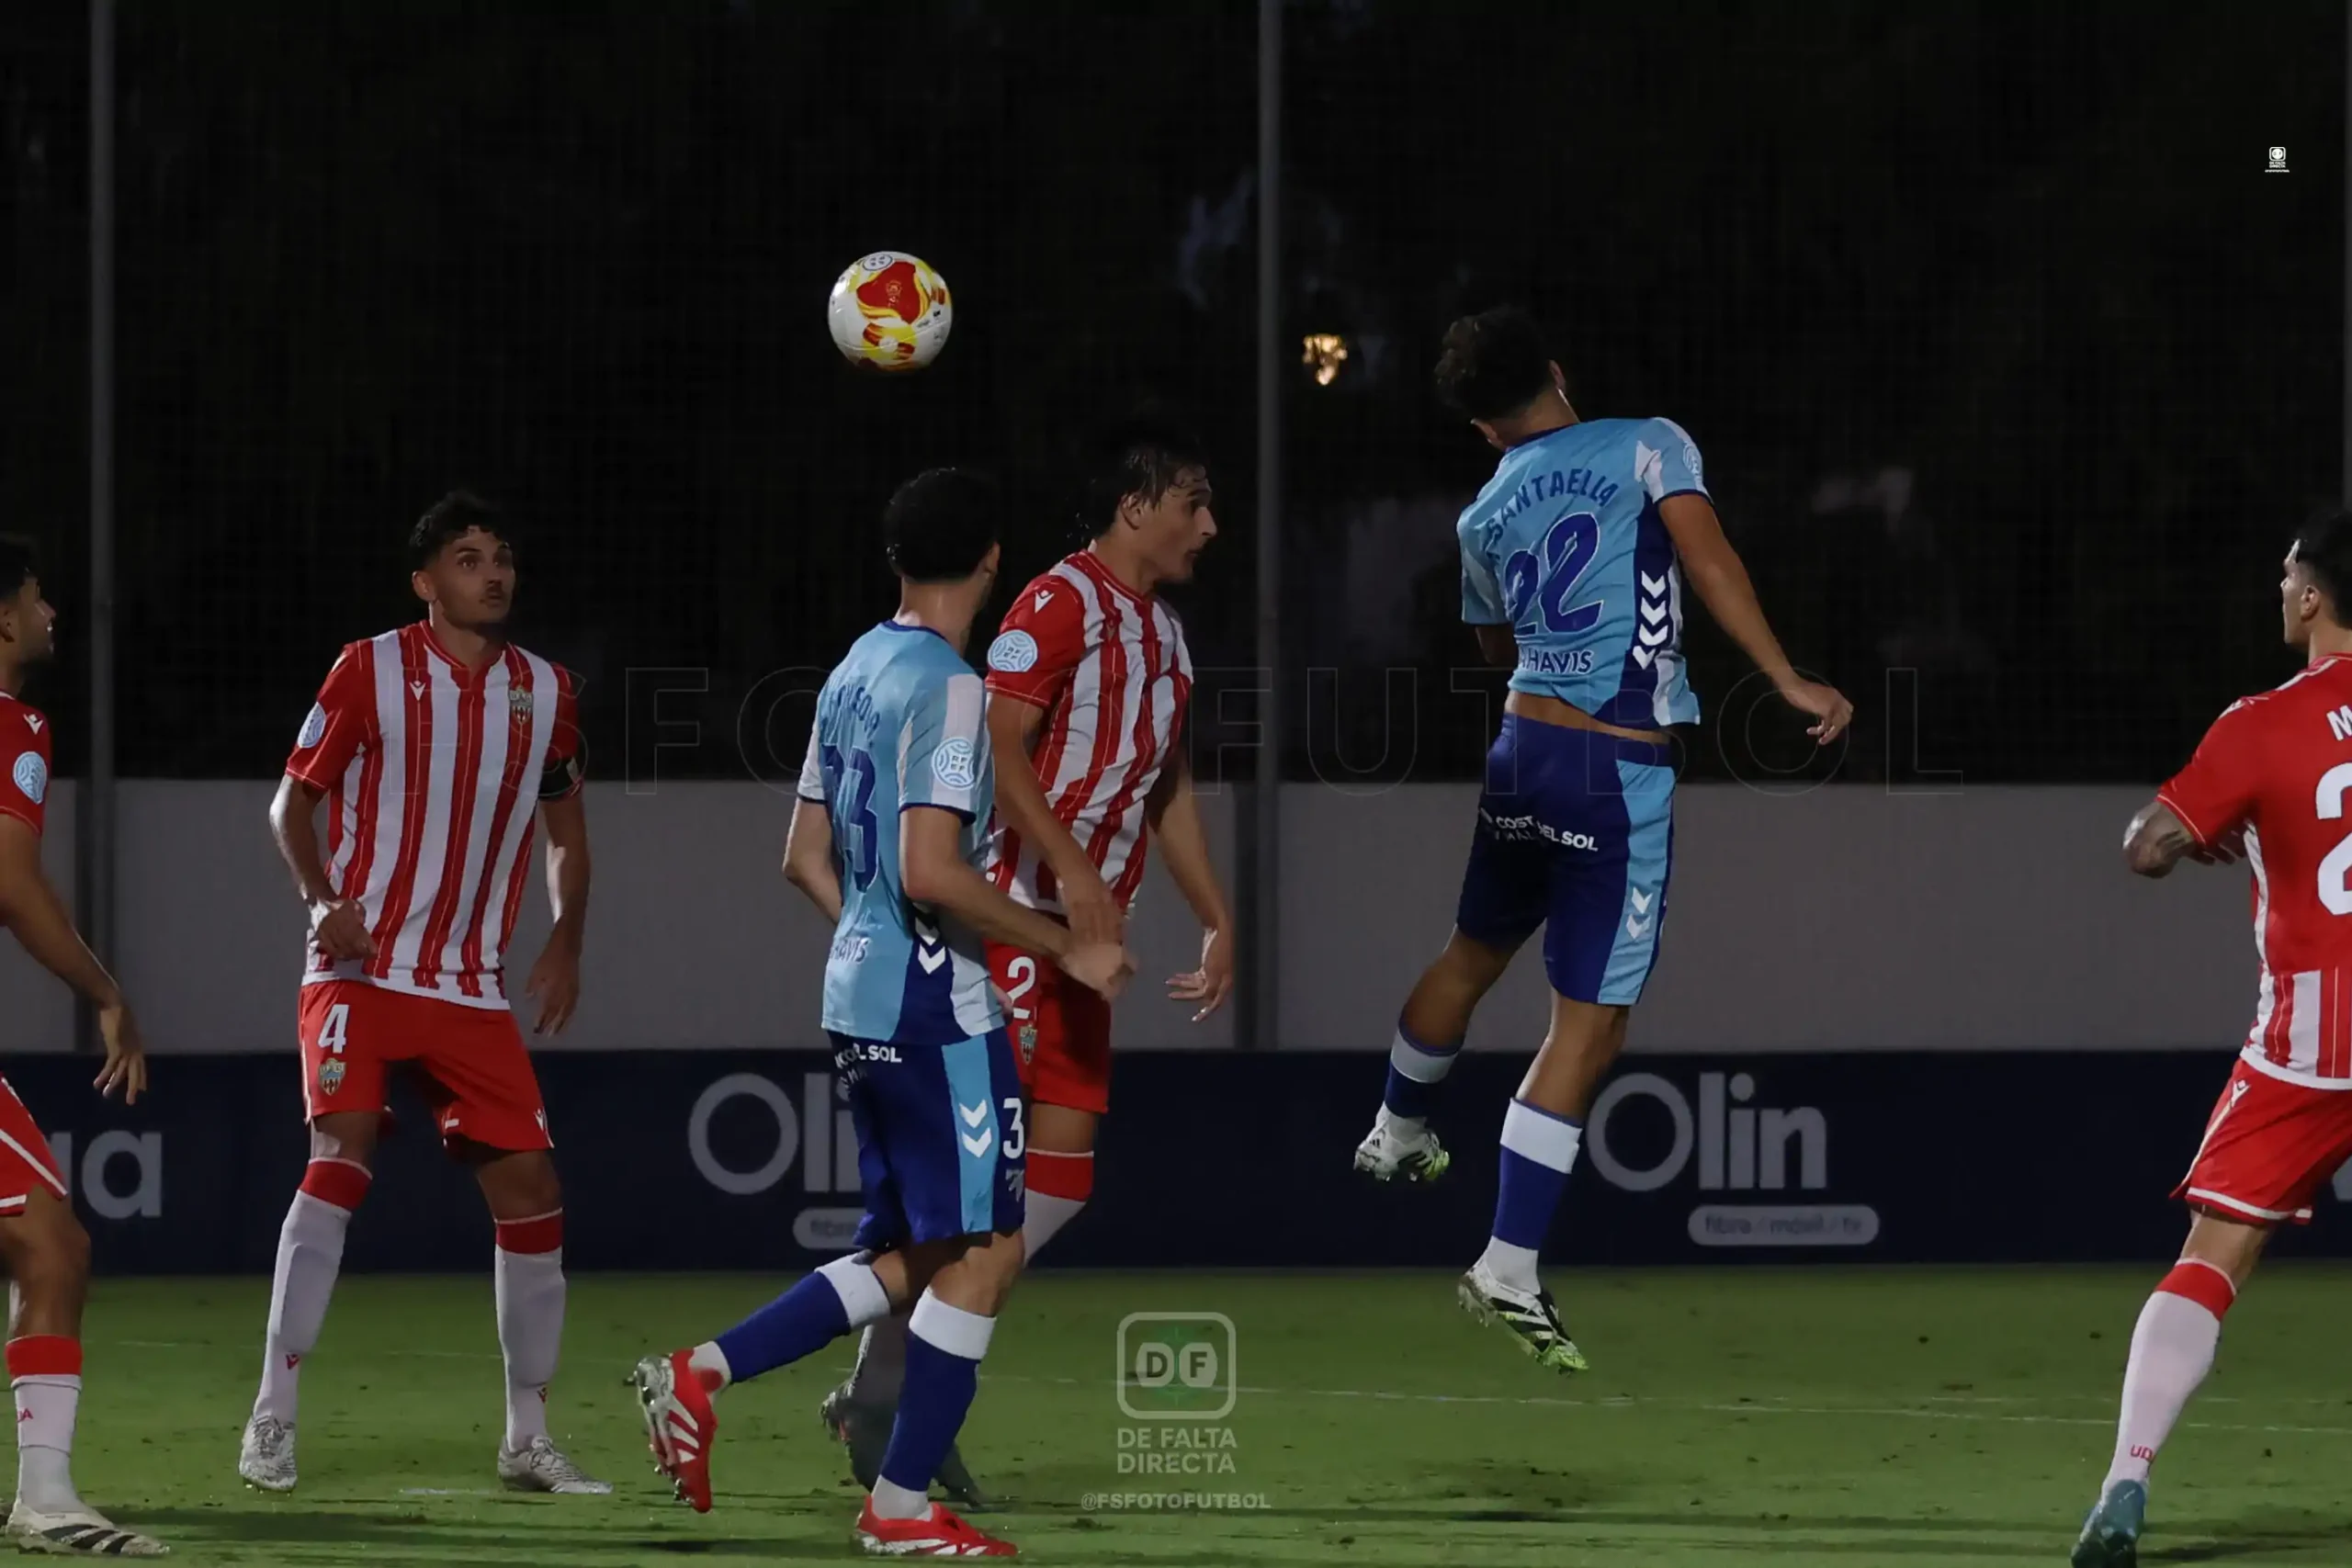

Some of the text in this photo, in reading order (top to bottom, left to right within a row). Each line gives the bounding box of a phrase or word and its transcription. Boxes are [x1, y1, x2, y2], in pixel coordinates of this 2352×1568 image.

[1504, 511, 1604, 637] 22
[1561, 830, 1599, 852] SOL
[1007, 955, 1036, 1020] 2
[317, 1003, 350, 1055] 4
[867, 1044, 903, 1064] SOL
[687, 1072, 863, 1195] Oli
[1002, 1097, 1024, 1159] 3
[1586, 1072, 1827, 1192] Olin
